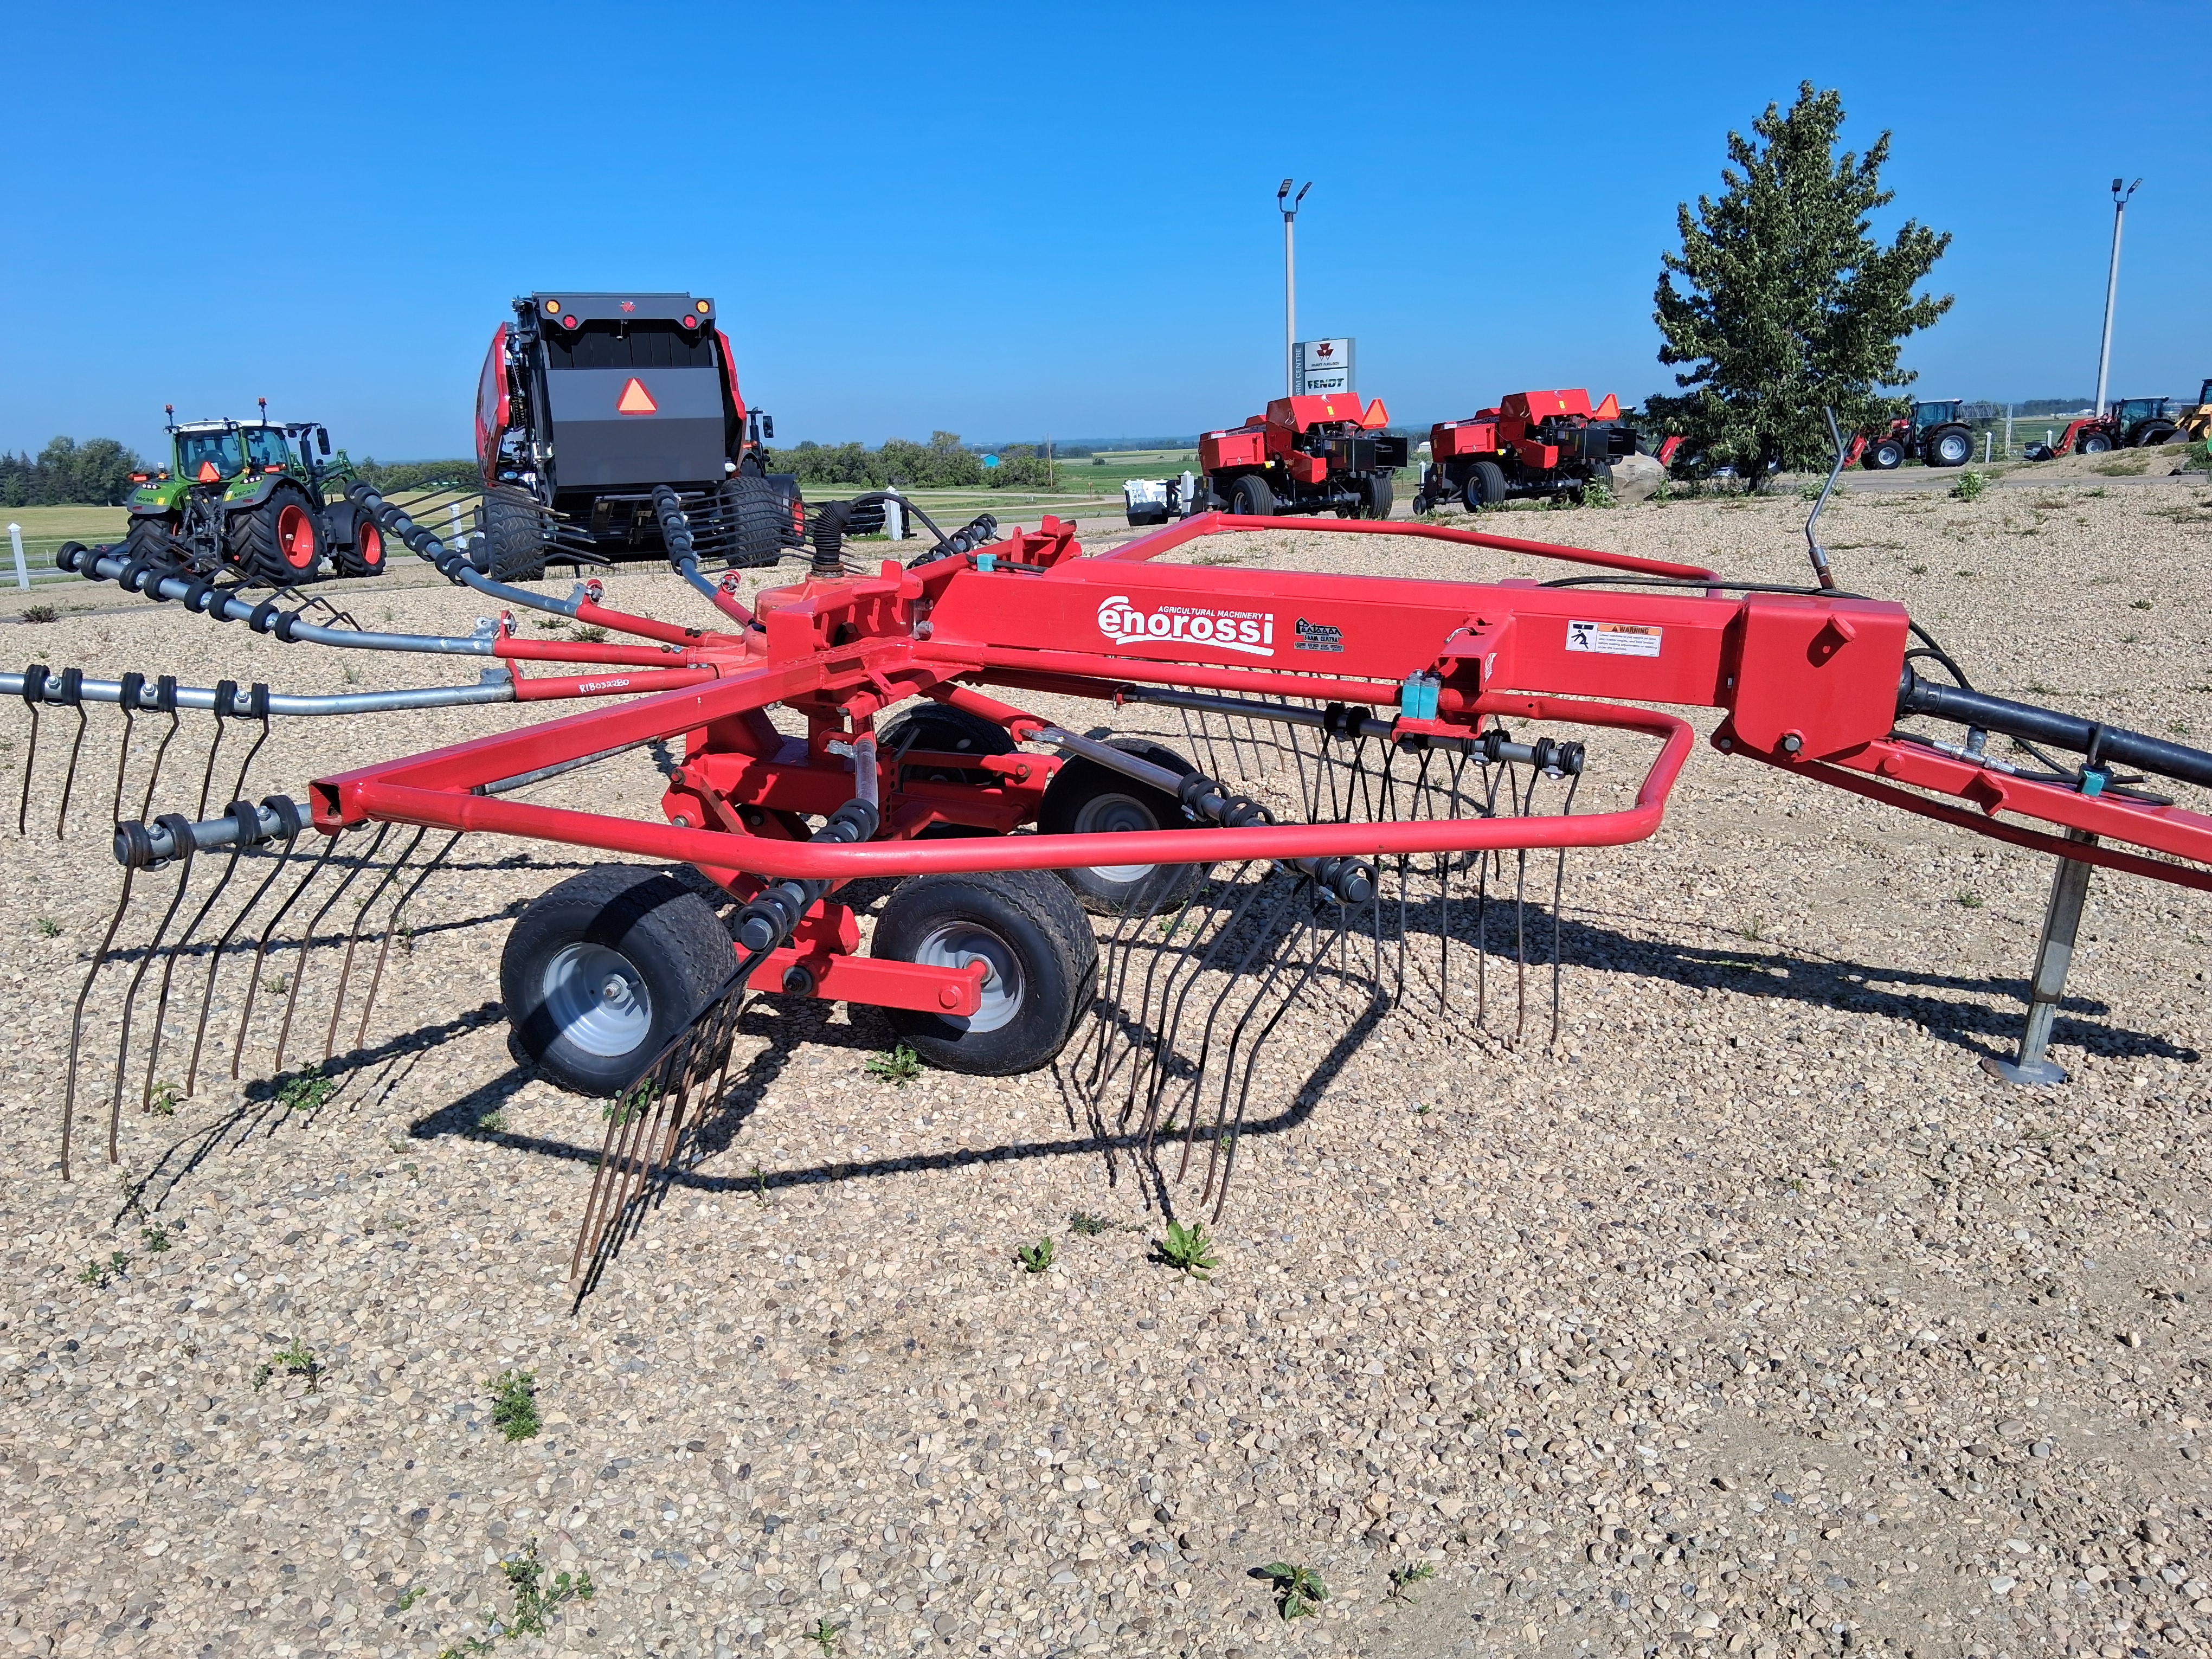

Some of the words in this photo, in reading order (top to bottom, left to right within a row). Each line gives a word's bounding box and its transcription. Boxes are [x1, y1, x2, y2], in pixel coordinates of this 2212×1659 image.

[1307, 378, 1345, 389] FENDT
[1158, 605, 1216, 616] AGRICULTURAL
[1217, 609, 1264, 620] MACHINERY
[1098, 605, 1274, 645] enorossi
[1296, 618, 1343, 637] Pentagon
[1619, 626, 1649, 634] WARNING
